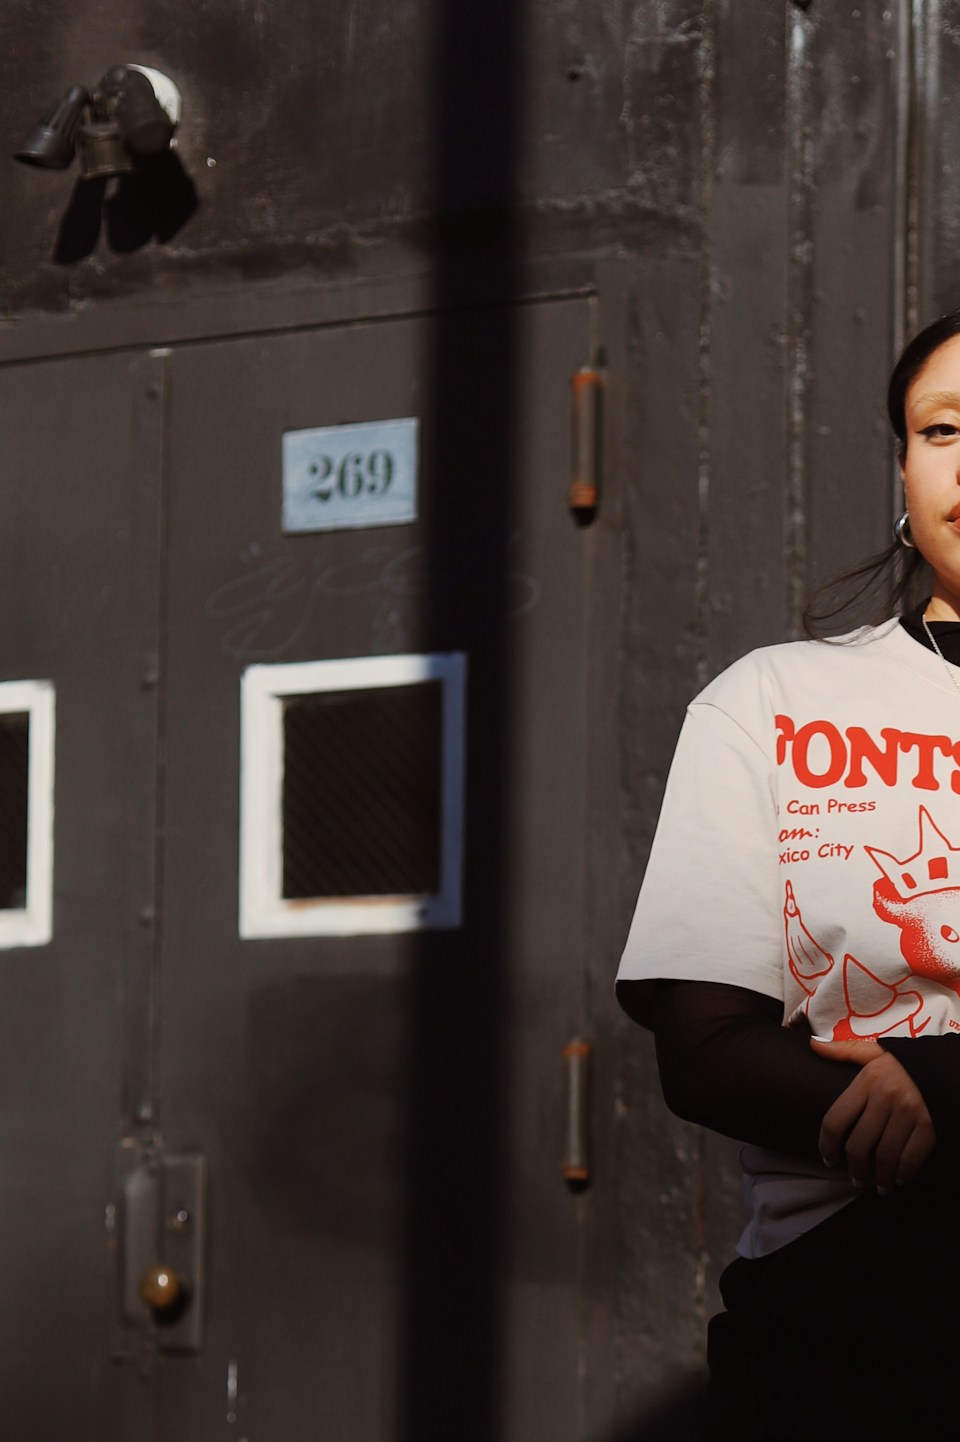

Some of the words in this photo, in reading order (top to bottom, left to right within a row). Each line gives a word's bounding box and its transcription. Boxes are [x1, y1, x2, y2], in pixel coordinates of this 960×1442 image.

[306, 447, 395, 505] 269
[786, 799, 821, 816] Can
[826, 798, 877, 814] Press
[777, 826, 820, 843] om:
[778, 847, 811, 865] xico
[817, 842, 855, 861] City
